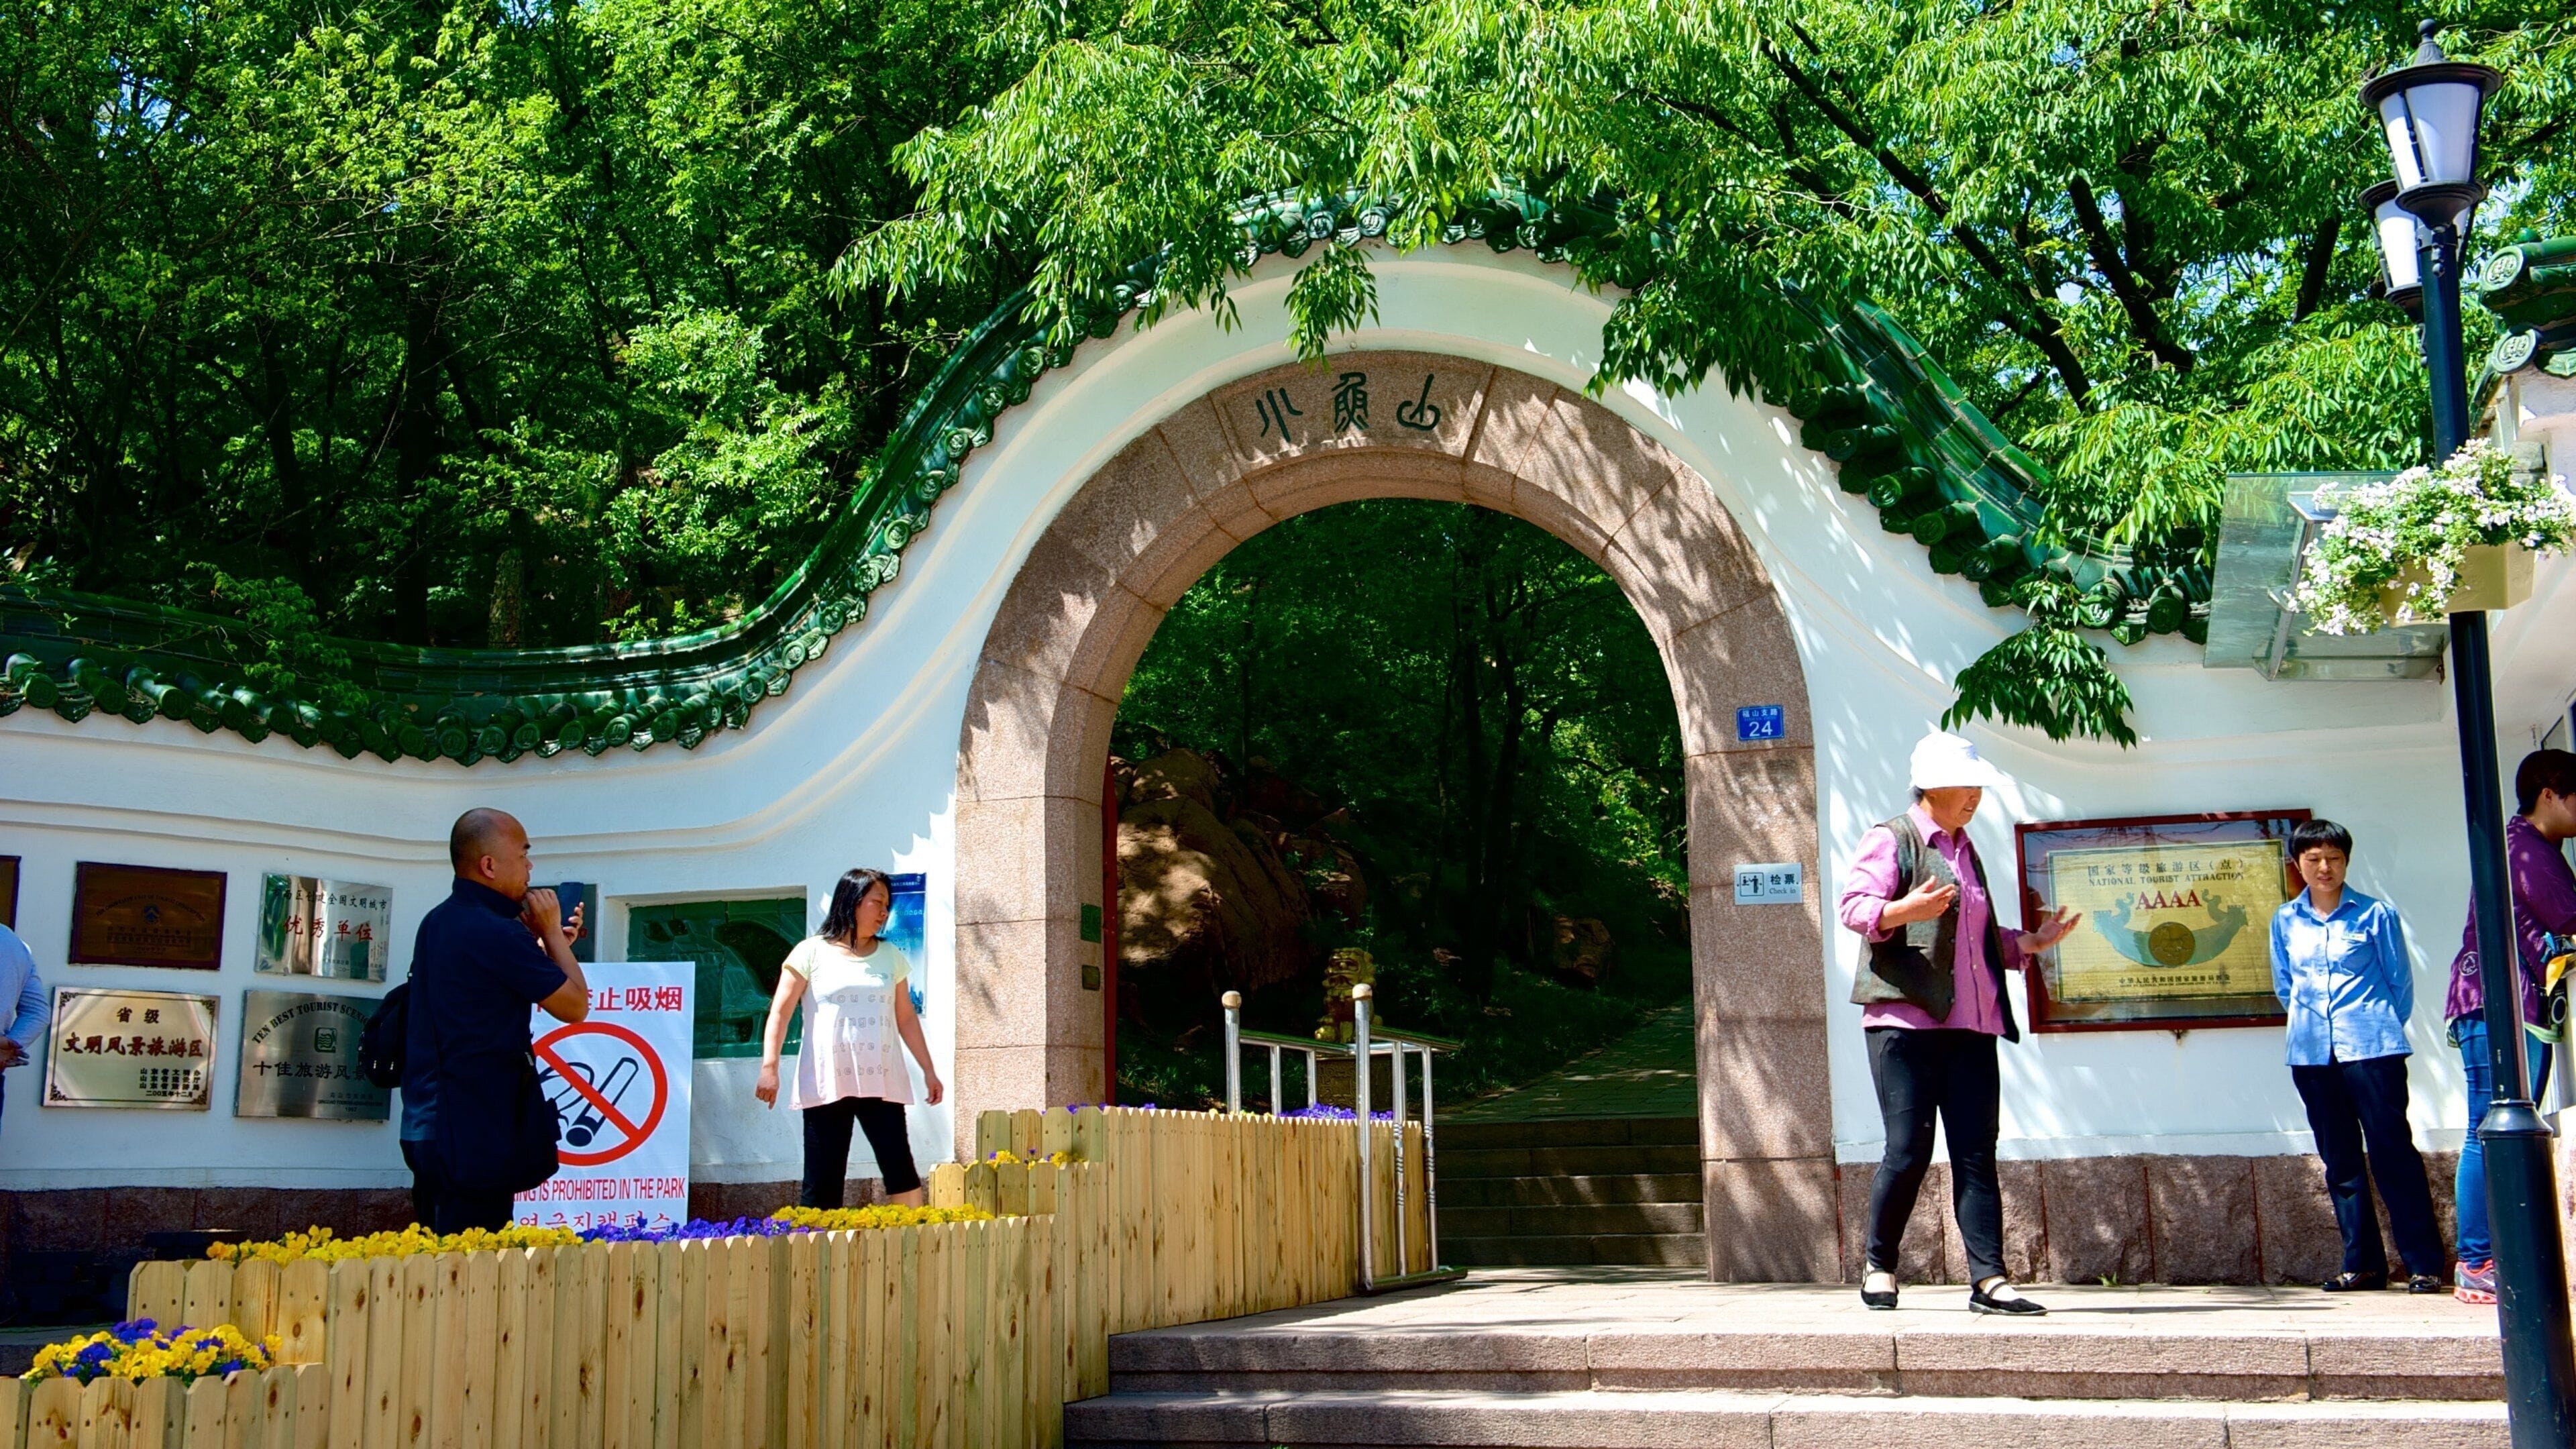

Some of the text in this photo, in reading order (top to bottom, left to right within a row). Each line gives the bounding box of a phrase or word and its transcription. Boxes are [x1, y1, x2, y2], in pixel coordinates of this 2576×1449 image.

[1749, 720, 1773, 737] 24
[1770, 874, 1795, 885] 检票
[2089, 872, 2244, 888] NATIONAL TOURIST ATTRACTION
[2136, 890, 2202, 910] AAAA
[283, 914, 374, 941] 优秀单位
[537, 986, 682, 1012] 止吸烟
[116, 1007, 160, 1024] 省级
[252, 1024, 271, 1044] TEN
[269, 1008, 294, 1028] BEST
[297, 1002, 339, 1015] TOURIST
[63, 1032, 203, 1058] 文明风景旅游区
[539, 1179, 549, 1201] IS
[552, 1179, 616, 1201] PROHIBITED
[619, 1178, 630, 1199] IN
[633, 1178, 653, 1199] THE
[657, 1177, 686, 1198] PARK
